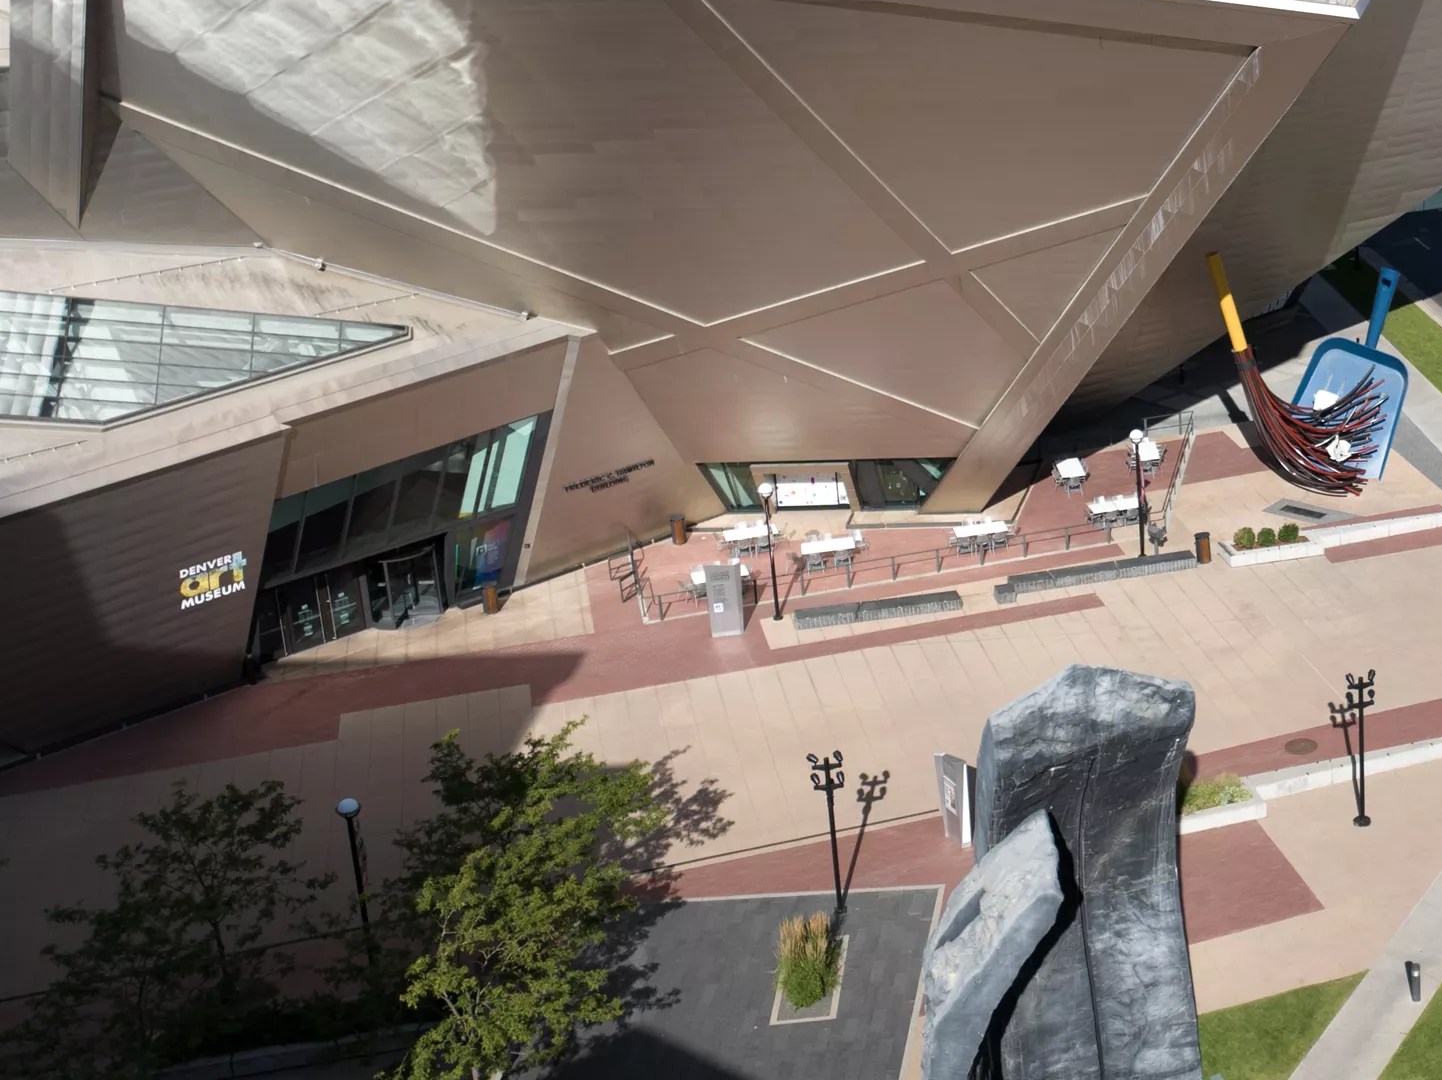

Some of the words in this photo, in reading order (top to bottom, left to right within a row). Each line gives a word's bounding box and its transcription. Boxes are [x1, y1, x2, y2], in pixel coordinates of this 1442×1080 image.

[179, 554, 232, 579] DENVER
[180, 550, 247, 598] art
[180, 580, 246, 610] MUSEUM
